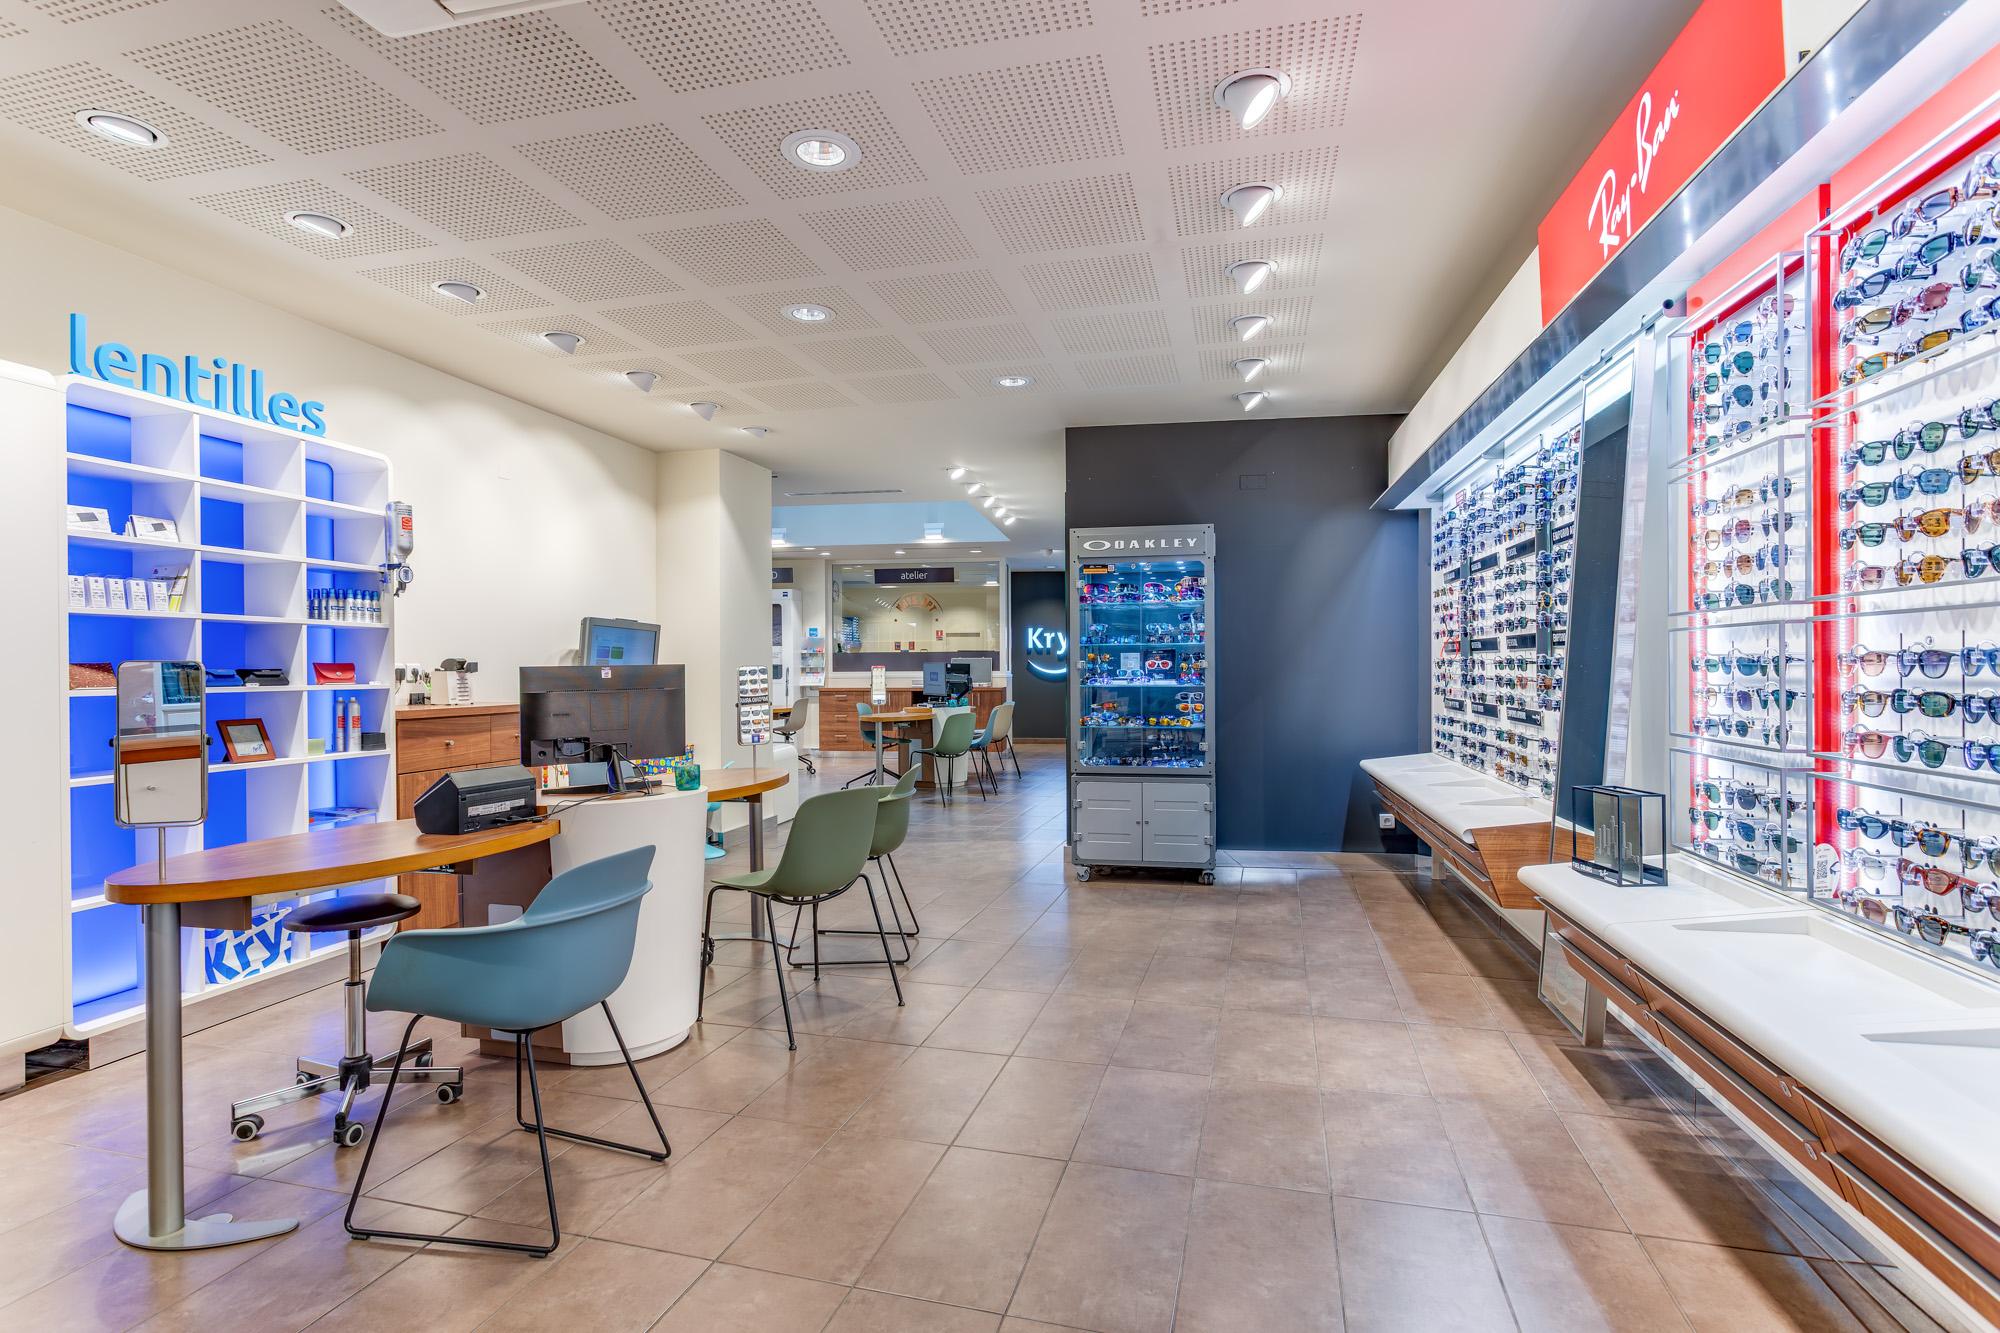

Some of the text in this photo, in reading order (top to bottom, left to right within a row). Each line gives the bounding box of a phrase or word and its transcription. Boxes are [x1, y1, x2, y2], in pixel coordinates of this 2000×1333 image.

[68, 313, 326, 438] lentilles
[1114, 538, 1198, 550] OAKLEY
[900, 571, 928, 580] atelier
